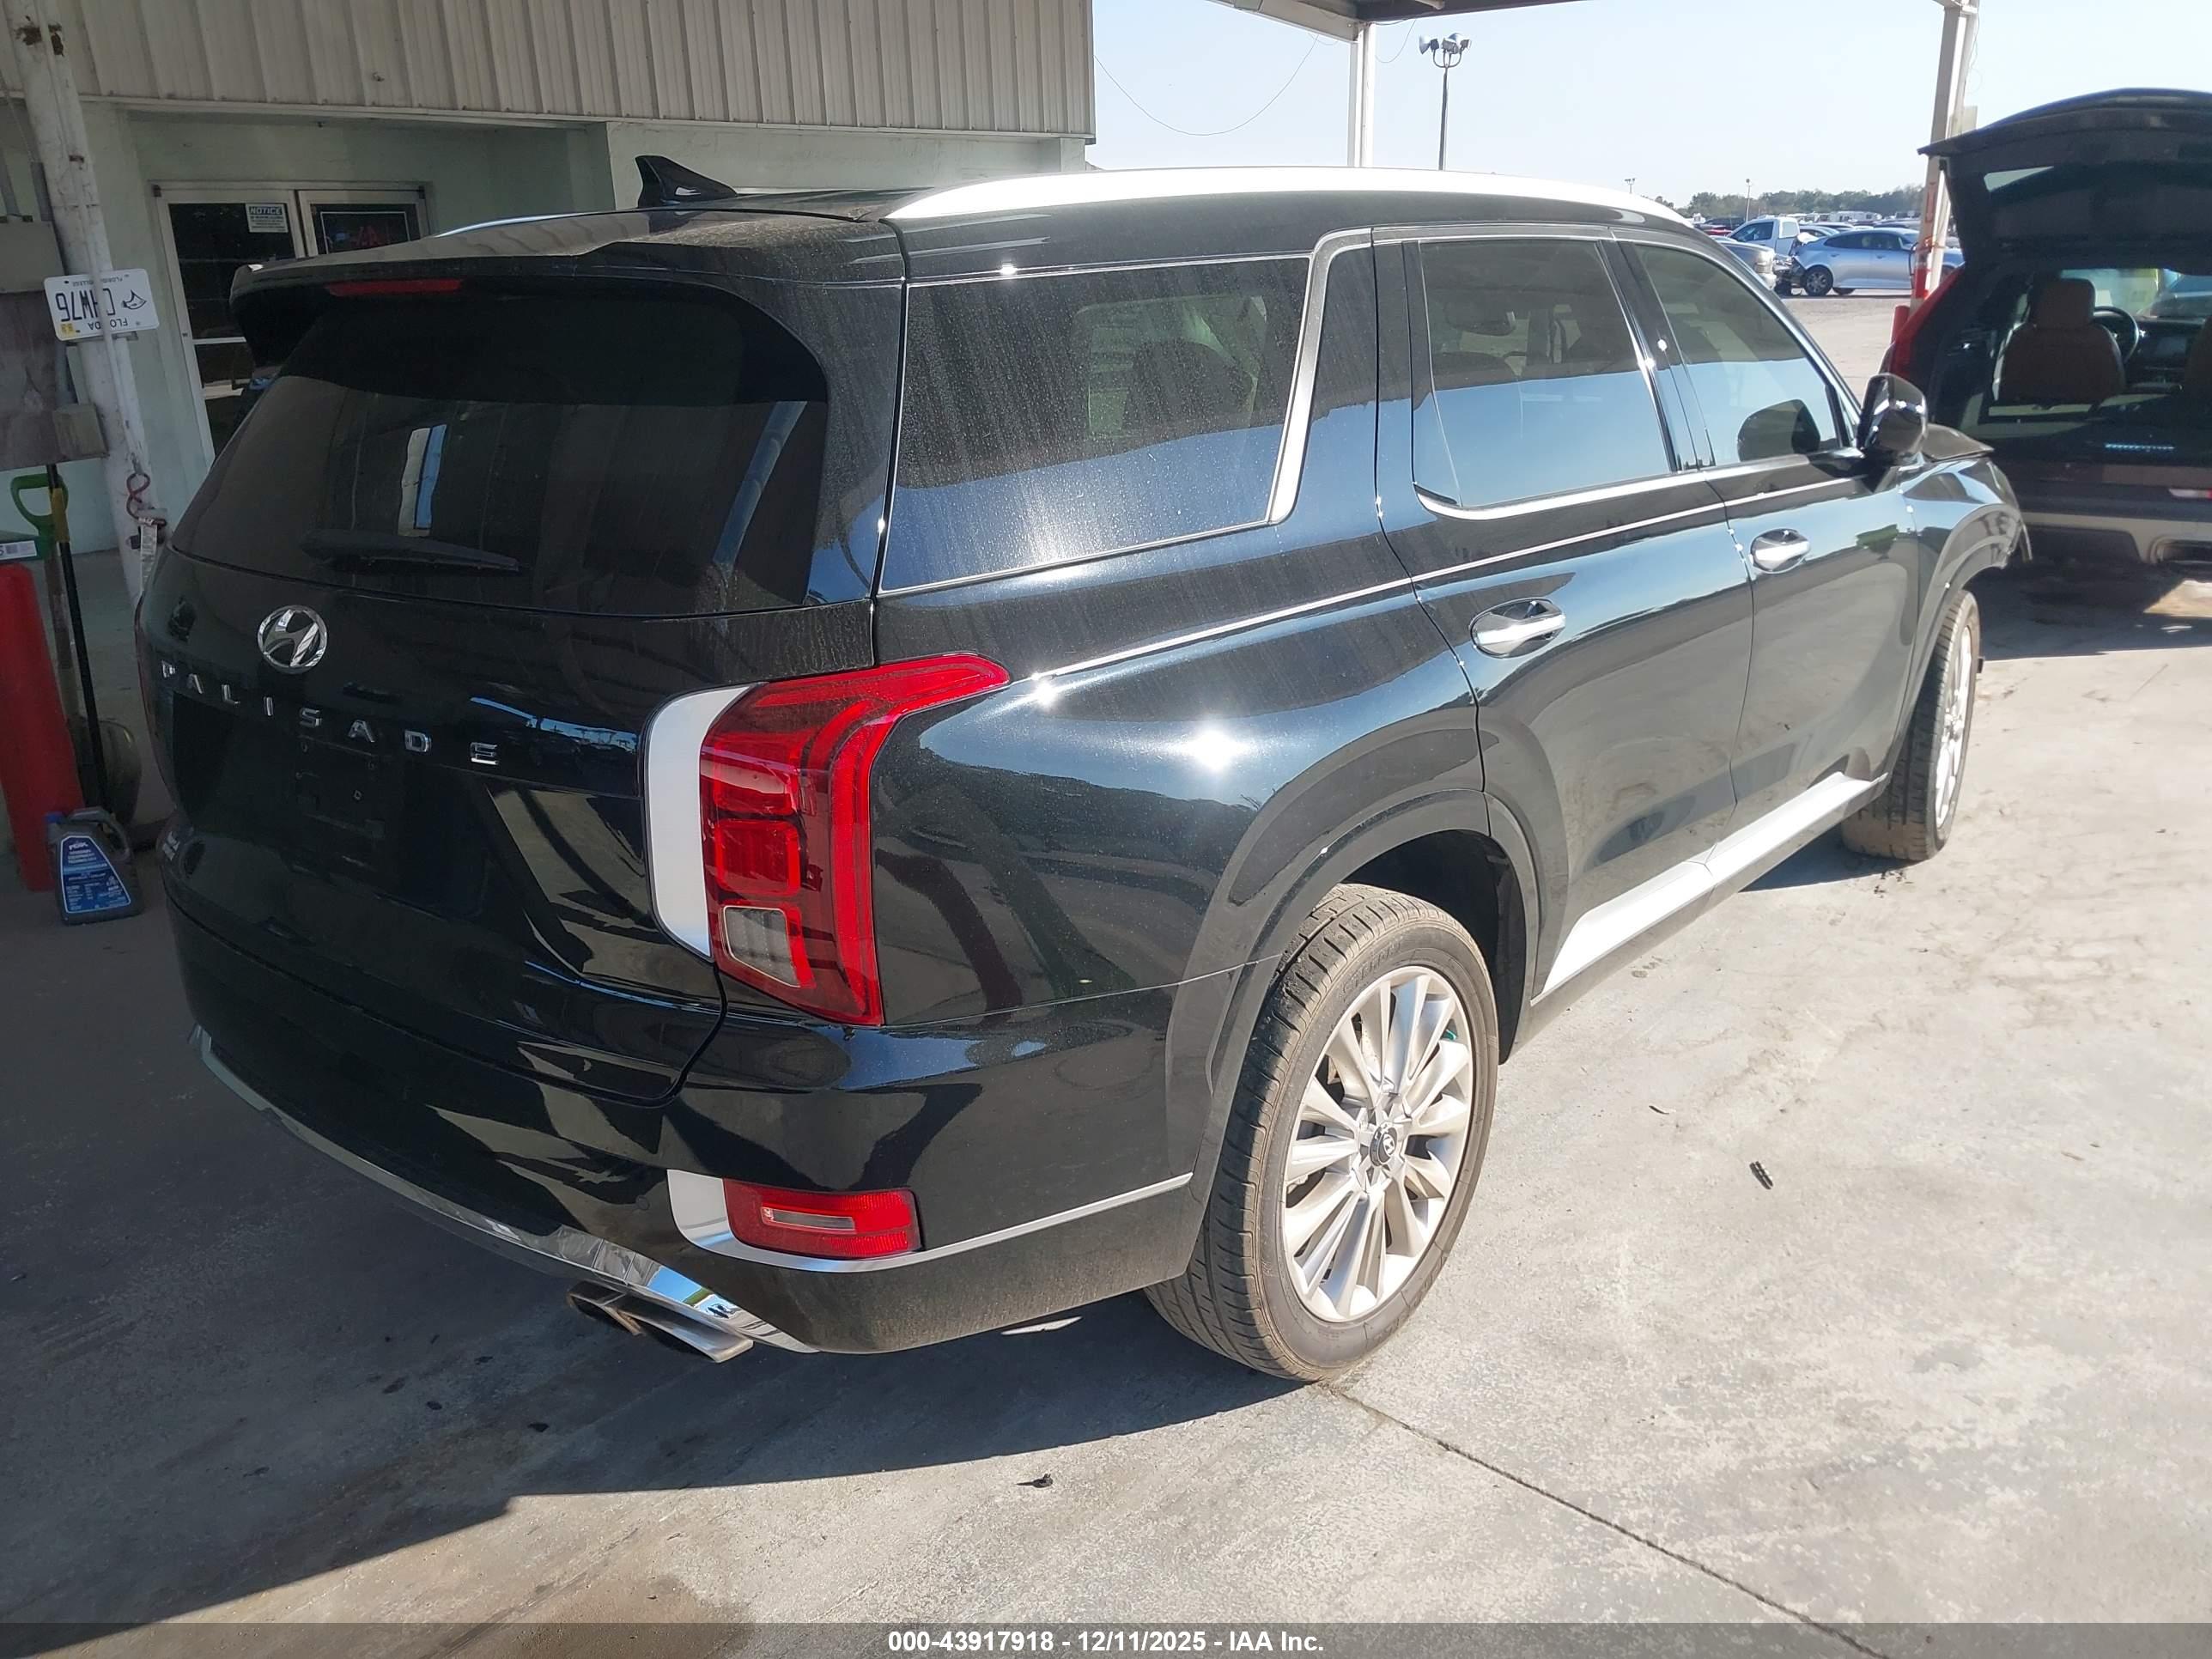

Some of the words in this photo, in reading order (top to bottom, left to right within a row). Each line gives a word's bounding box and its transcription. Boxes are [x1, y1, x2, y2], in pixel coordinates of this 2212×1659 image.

[249, 206, 282, 215] NOTICE
[88, 318, 128, 331] FLODA
[161, 659, 499, 765] PALISADE
